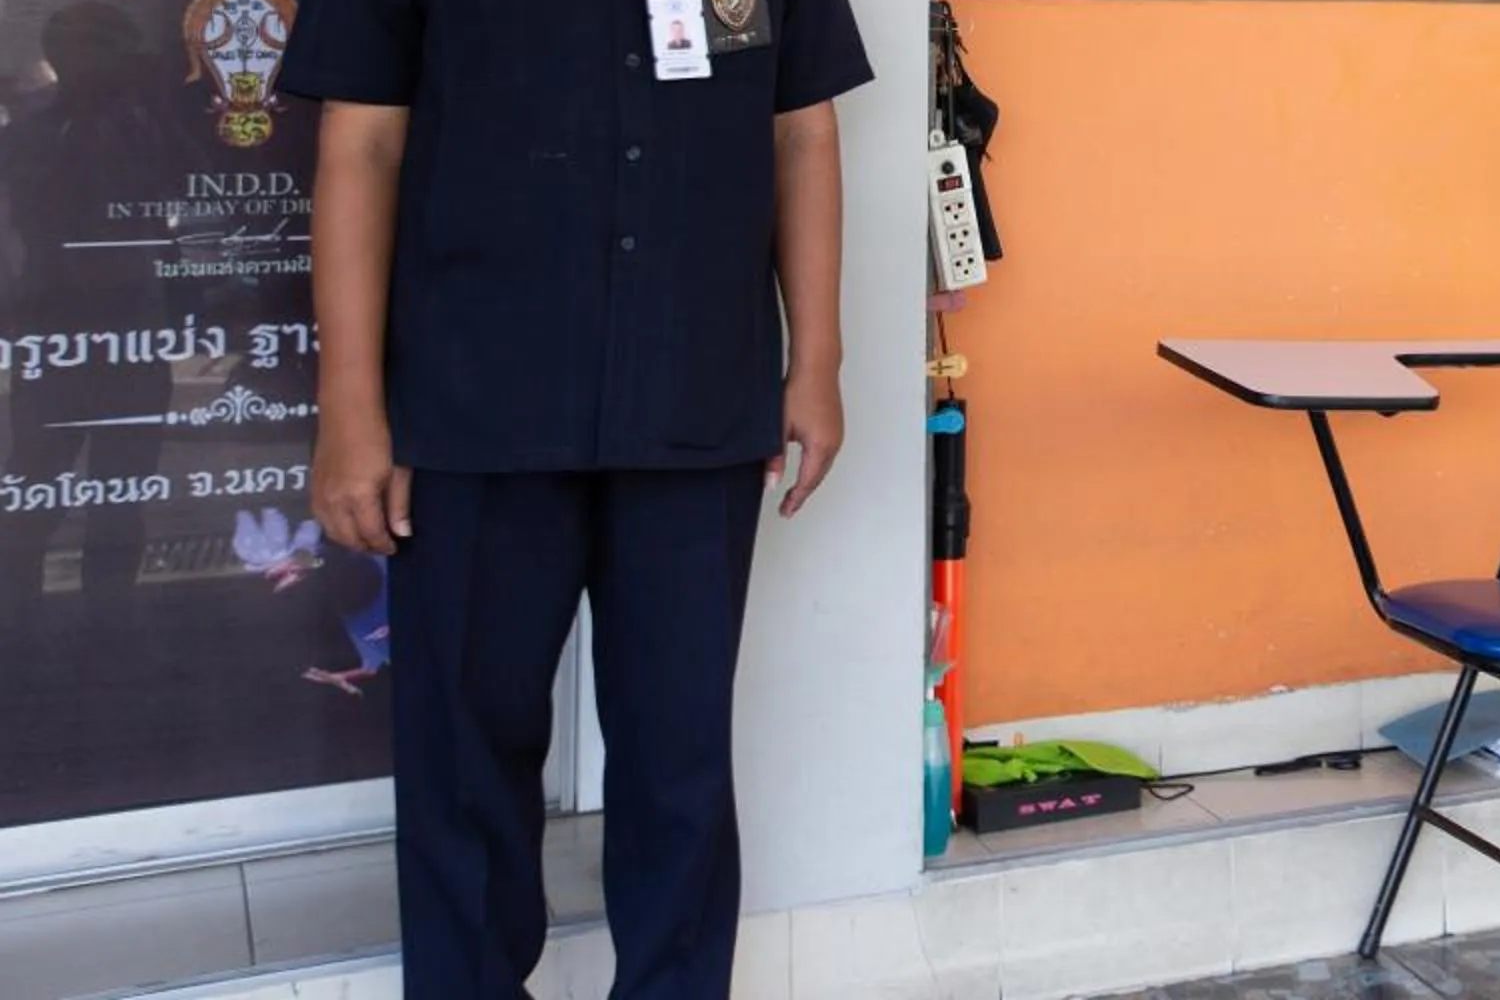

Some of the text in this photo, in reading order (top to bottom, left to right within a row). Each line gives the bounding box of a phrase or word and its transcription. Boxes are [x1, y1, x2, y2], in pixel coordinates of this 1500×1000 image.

[186, 172, 300, 197] IN.D.D.
[107, 203, 133, 220] IN
[139, 201, 190, 218] THE
[195, 200, 240, 217] DAY
[244, 199, 276, 215] OF
[248, 322, 320, 369] ฐา
